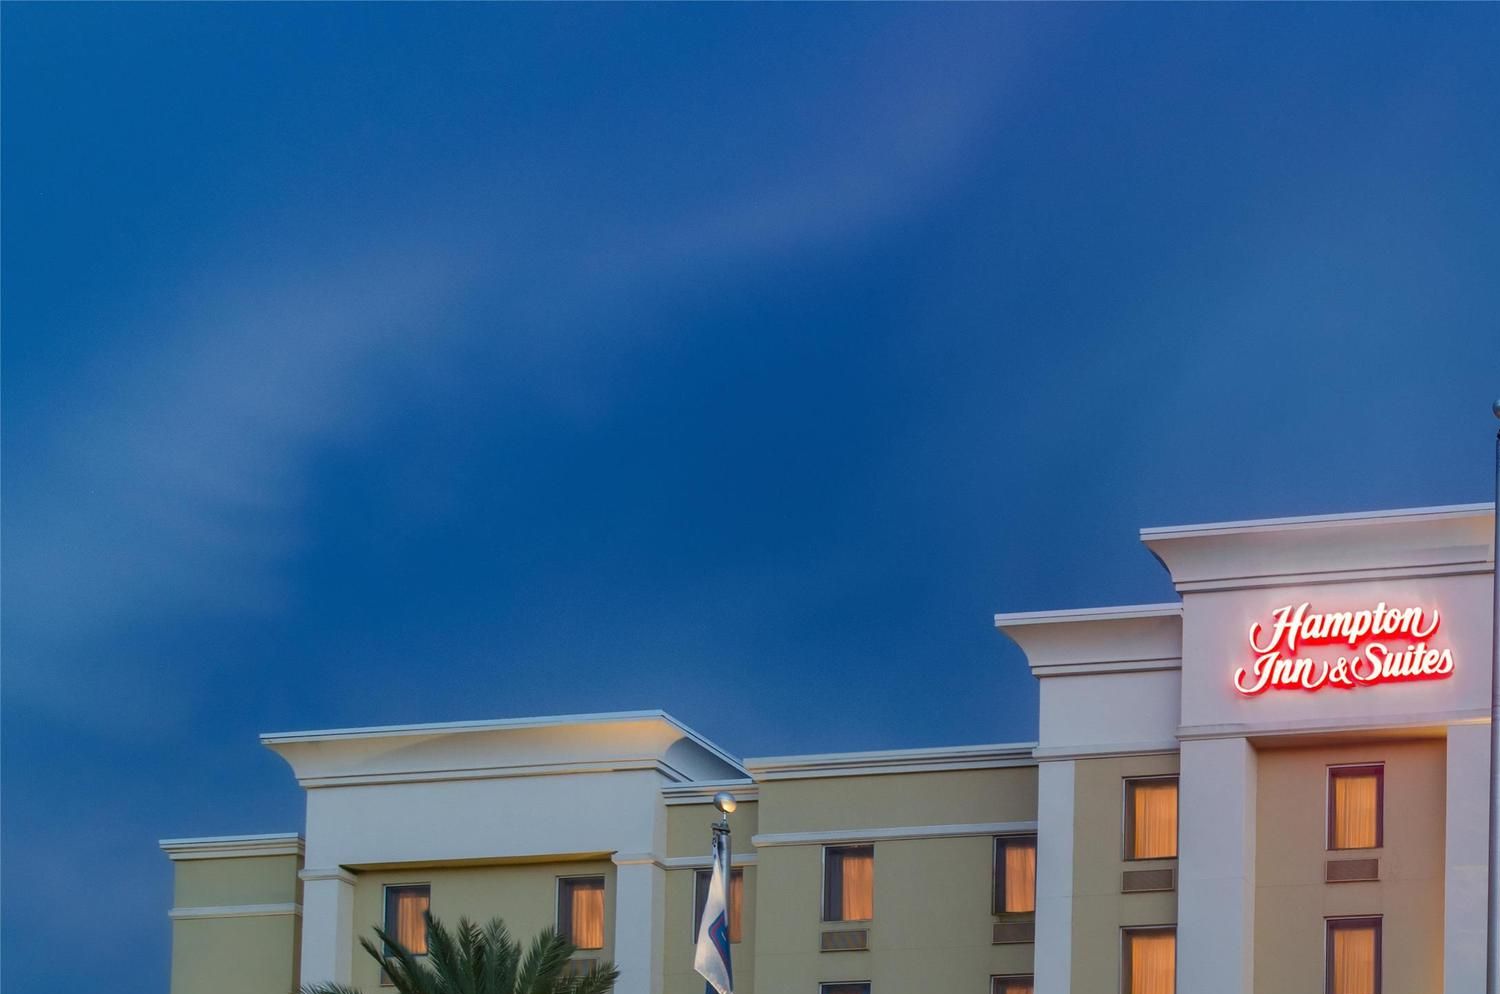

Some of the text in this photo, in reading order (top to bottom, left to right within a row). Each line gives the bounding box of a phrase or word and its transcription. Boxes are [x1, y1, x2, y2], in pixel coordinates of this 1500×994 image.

[1250, 602, 1440, 654] Hampton
[1234, 642, 1454, 693] Inn & Suites
